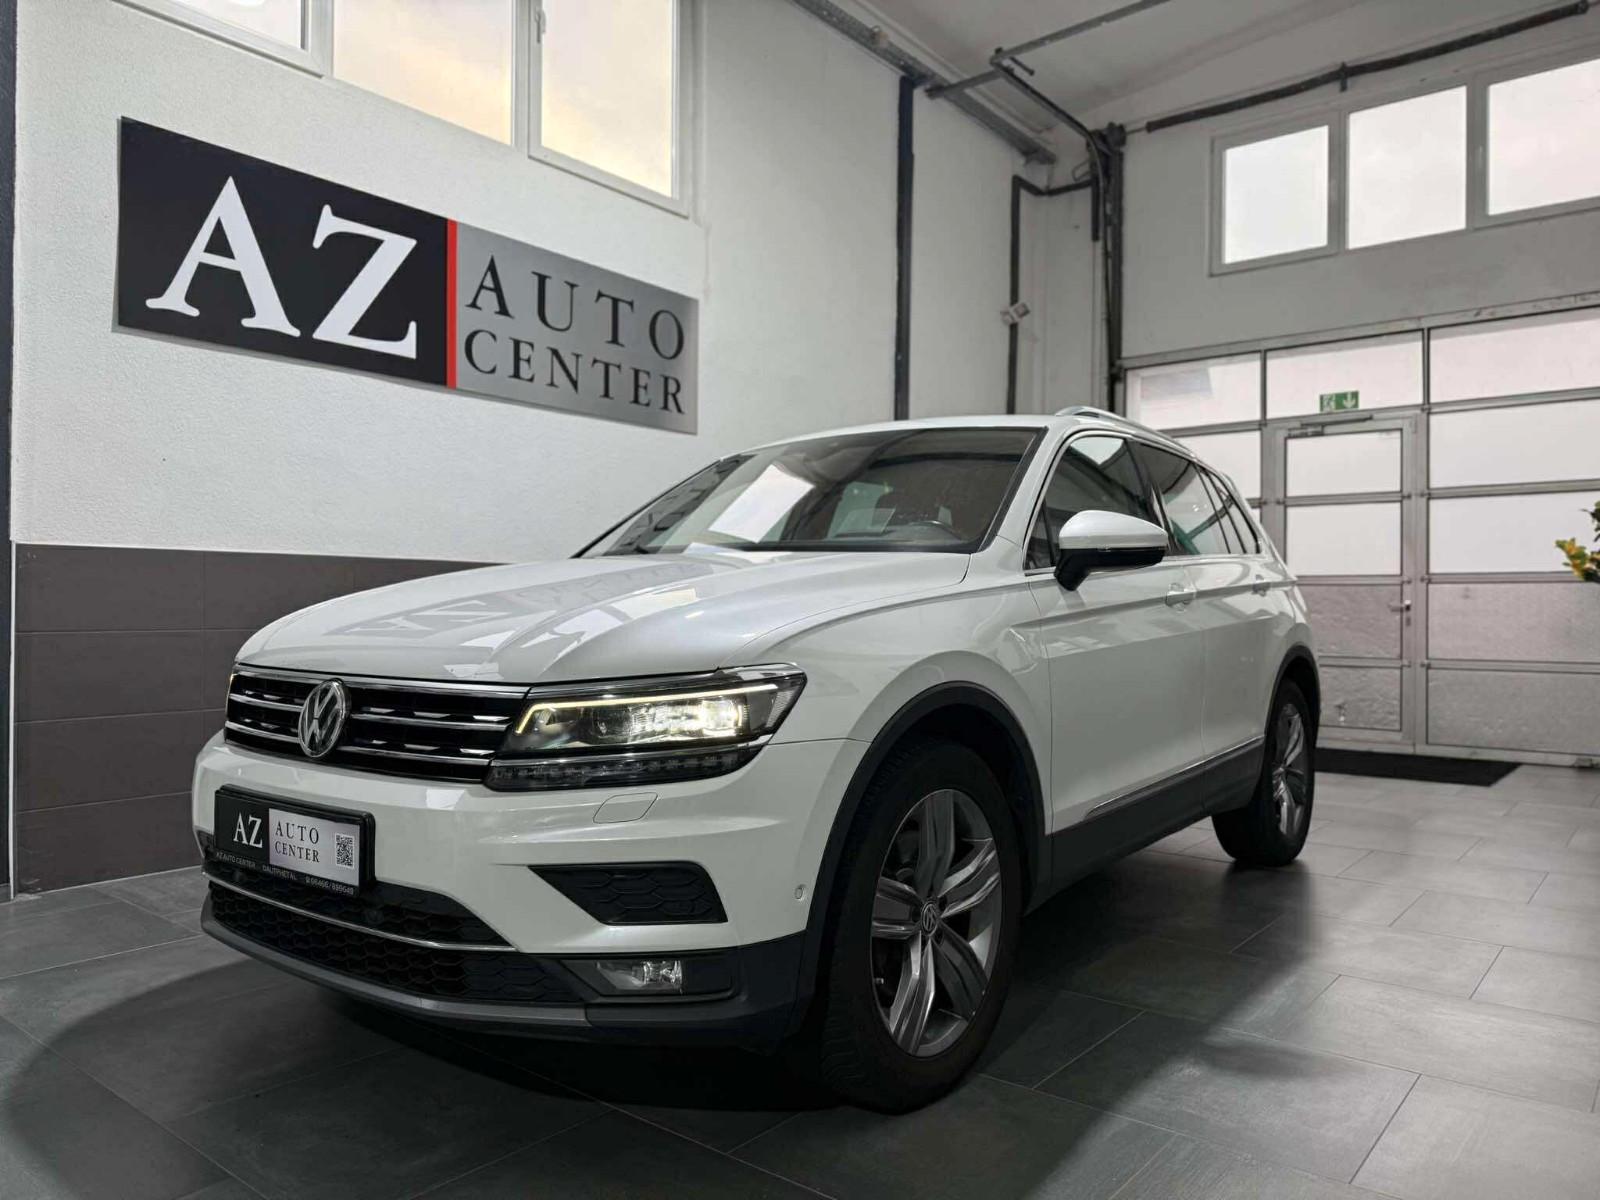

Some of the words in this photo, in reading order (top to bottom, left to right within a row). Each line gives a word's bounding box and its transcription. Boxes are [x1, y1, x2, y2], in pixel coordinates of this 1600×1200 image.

[145, 175, 418, 360] AZ
[464, 255, 685, 360] AUTO
[463, 329, 685, 414] CENTER
[233, 812, 263, 849] AZ
[275, 820, 320, 845] AUTO
[235, 856, 256, 869] CENTER
[275, 840, 320, 863] CENTER
